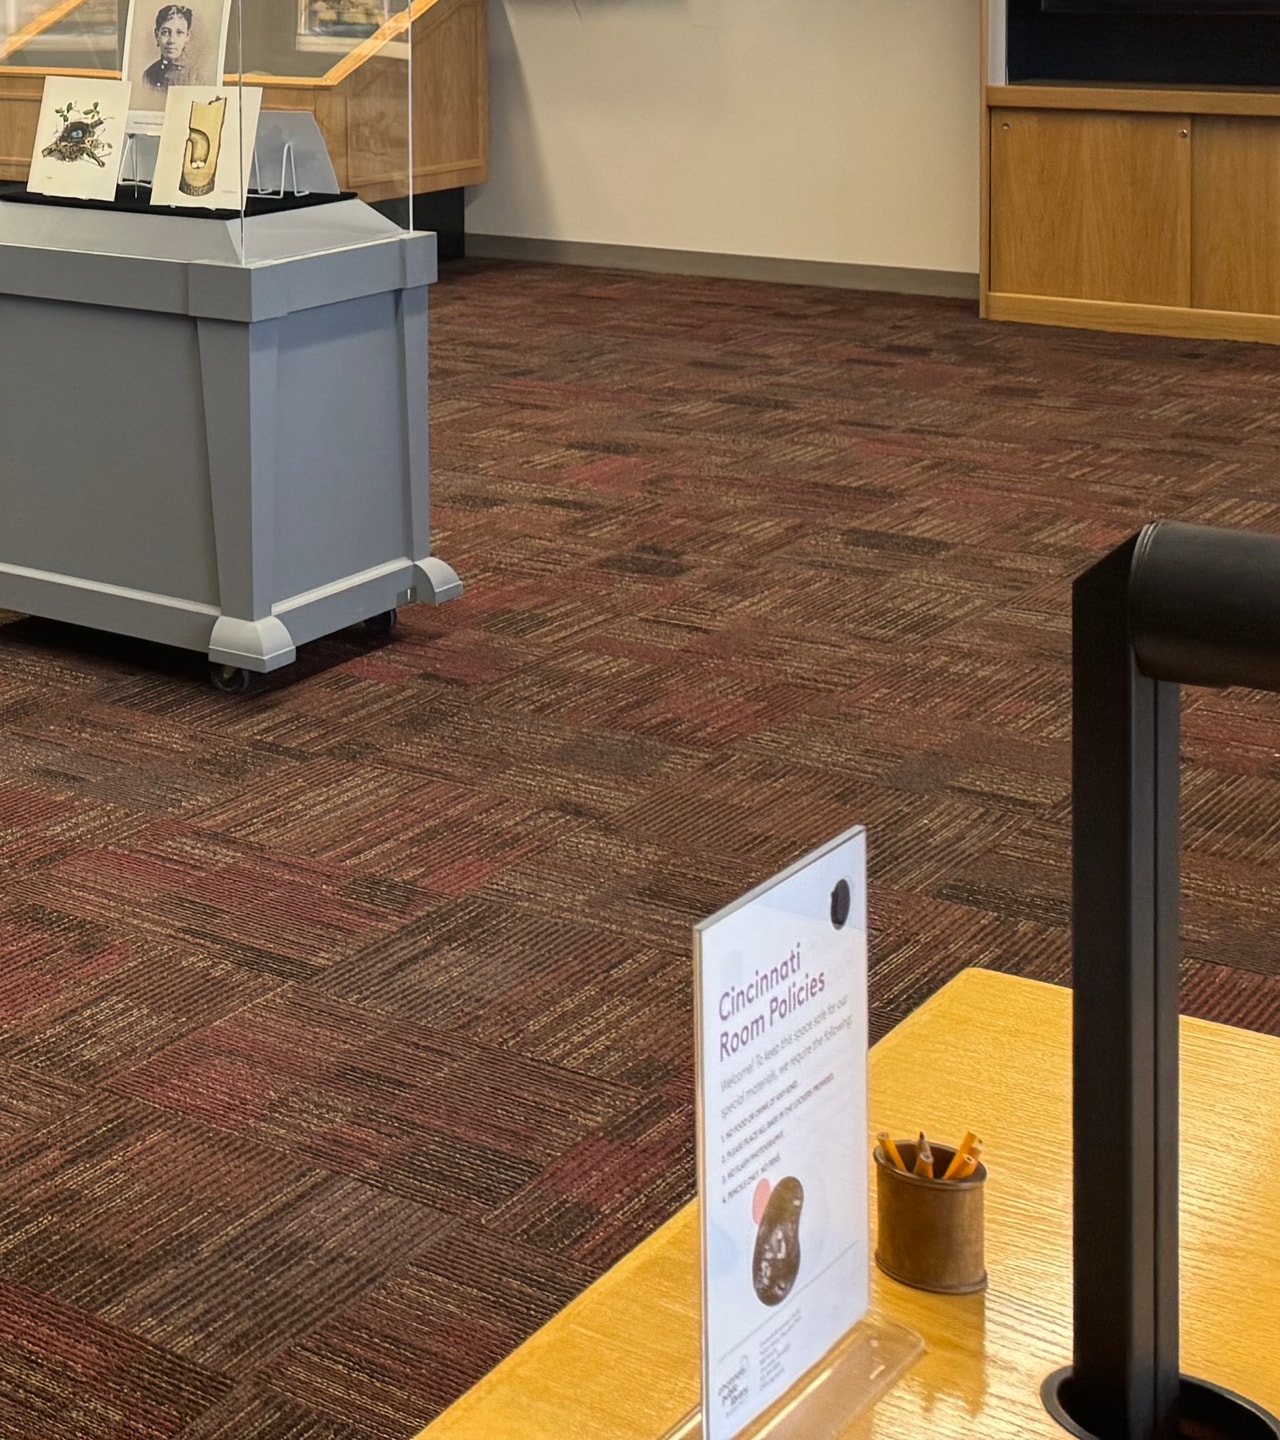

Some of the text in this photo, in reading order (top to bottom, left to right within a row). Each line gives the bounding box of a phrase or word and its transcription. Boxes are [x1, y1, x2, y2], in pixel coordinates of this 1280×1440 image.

[718, 941, 801, 1022] Cincinnati
[719, 971, 825, 1062] Room Policies
